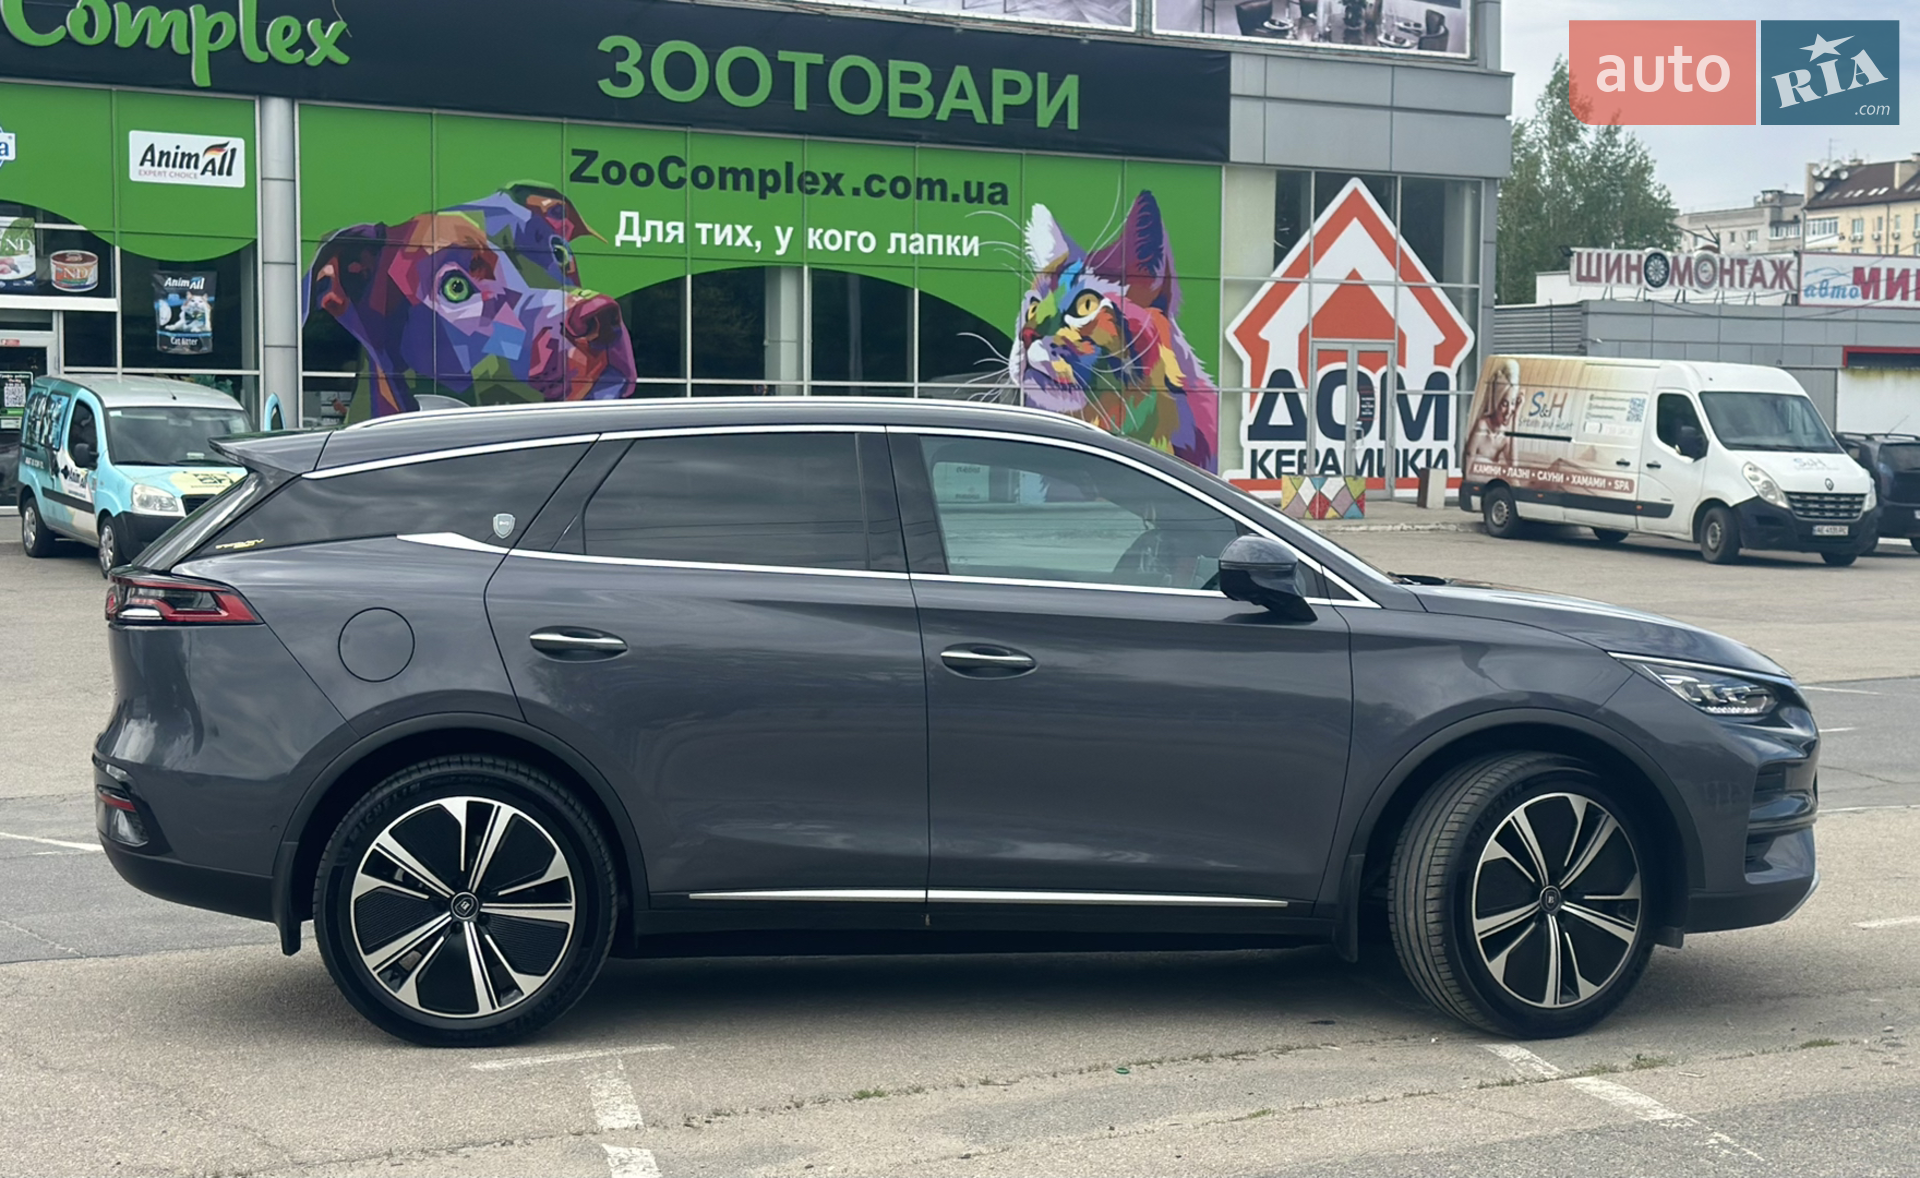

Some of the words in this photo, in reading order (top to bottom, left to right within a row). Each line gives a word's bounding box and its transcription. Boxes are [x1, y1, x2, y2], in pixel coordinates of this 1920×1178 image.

[597, 36, 1079, 130] ЗООТОВАРИ
[138, 169, 167, 178] EXPERT
[169, 171, 198, 180] CHOICE
[570, 148, 1009, 206] ZooComplex.com.ua
[615, 211, 685, 246] Для
[696, 220, 763, 252] тих,
[775, 227, 794, 256] у
[807, 226, 877, 254] кого
[887, 232, 980, 258] лапки
[1576, 248, 1795, 291] ШИНОМОНТАЖ
[1248, 368, 1449, 442] ДОМ
[1528, 391, 1568, 419] S&H
[1507, 467, 1530, 479] ЛАЗНІ
[1537, 470, 1564, 483] САУНИ
[1571, 475, 1606, 488] ХАМАМИ
[1613, 480, 1630, 491] SPA
